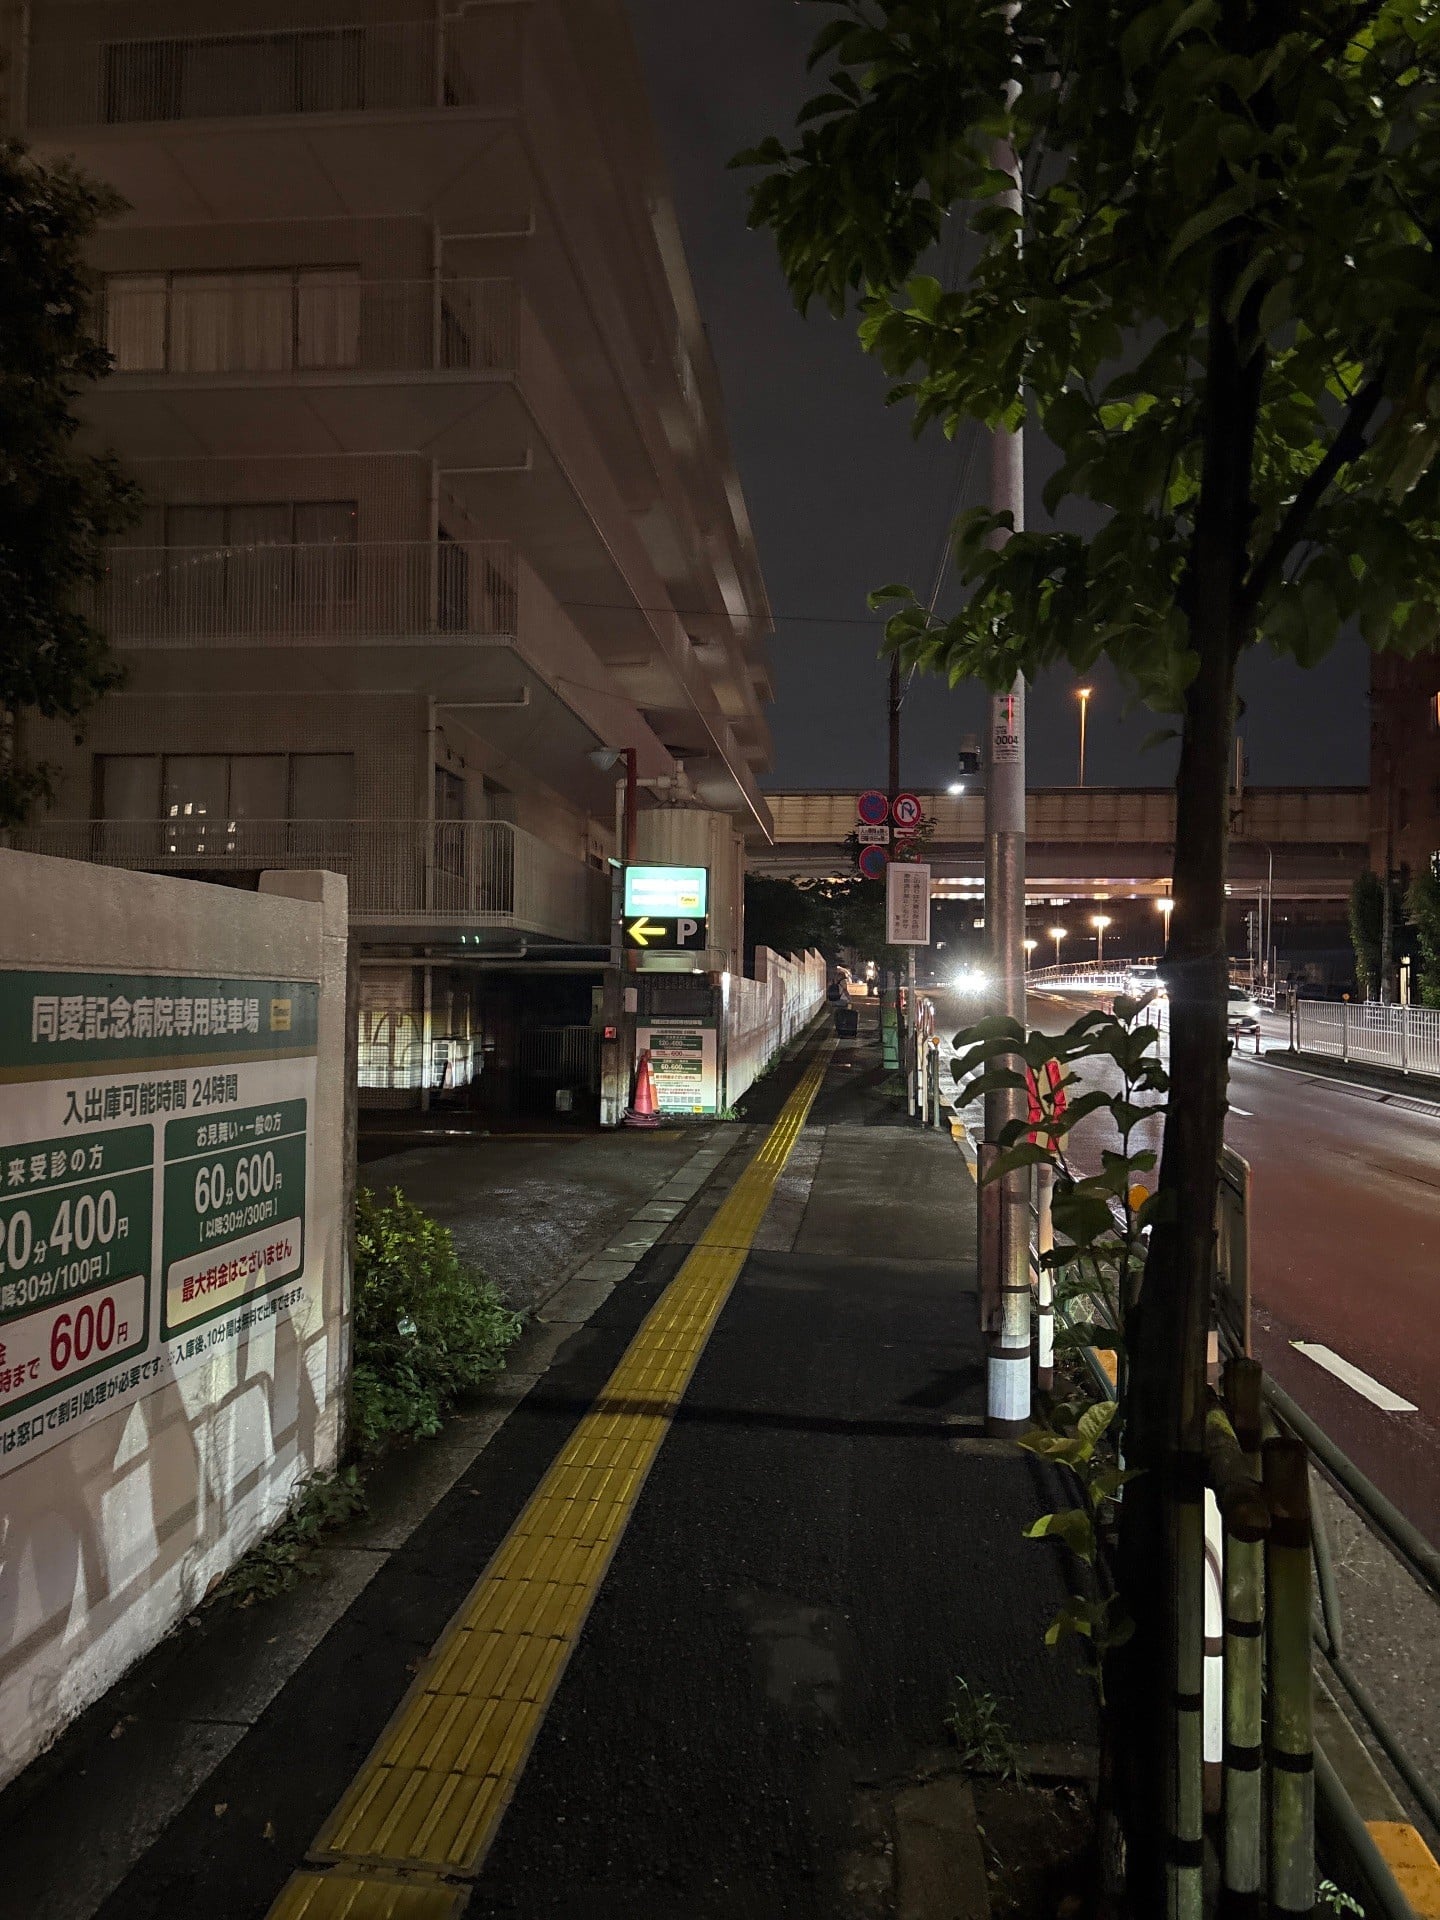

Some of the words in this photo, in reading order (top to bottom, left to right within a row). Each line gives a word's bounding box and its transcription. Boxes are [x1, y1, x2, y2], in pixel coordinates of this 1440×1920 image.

[677, 919, 698, 945] P
[32, 995, 259, 1043] 同愛記念病院専用駐車場
[63, 1079, 187, 1126] 入出庫可能時間
[192, 1074, 238, 1107] 24時間
[197, 1112, 282, 1147] お見舞い・一般の方
[0, 1144, 104, 1186] 来受診の方
[182, 1238, 292, 1303] 最大料金はございません
[50, 1297, 128, 1371] 600円
[0, 1357, 164, 1454] は窓口で割引処理が必要です。
